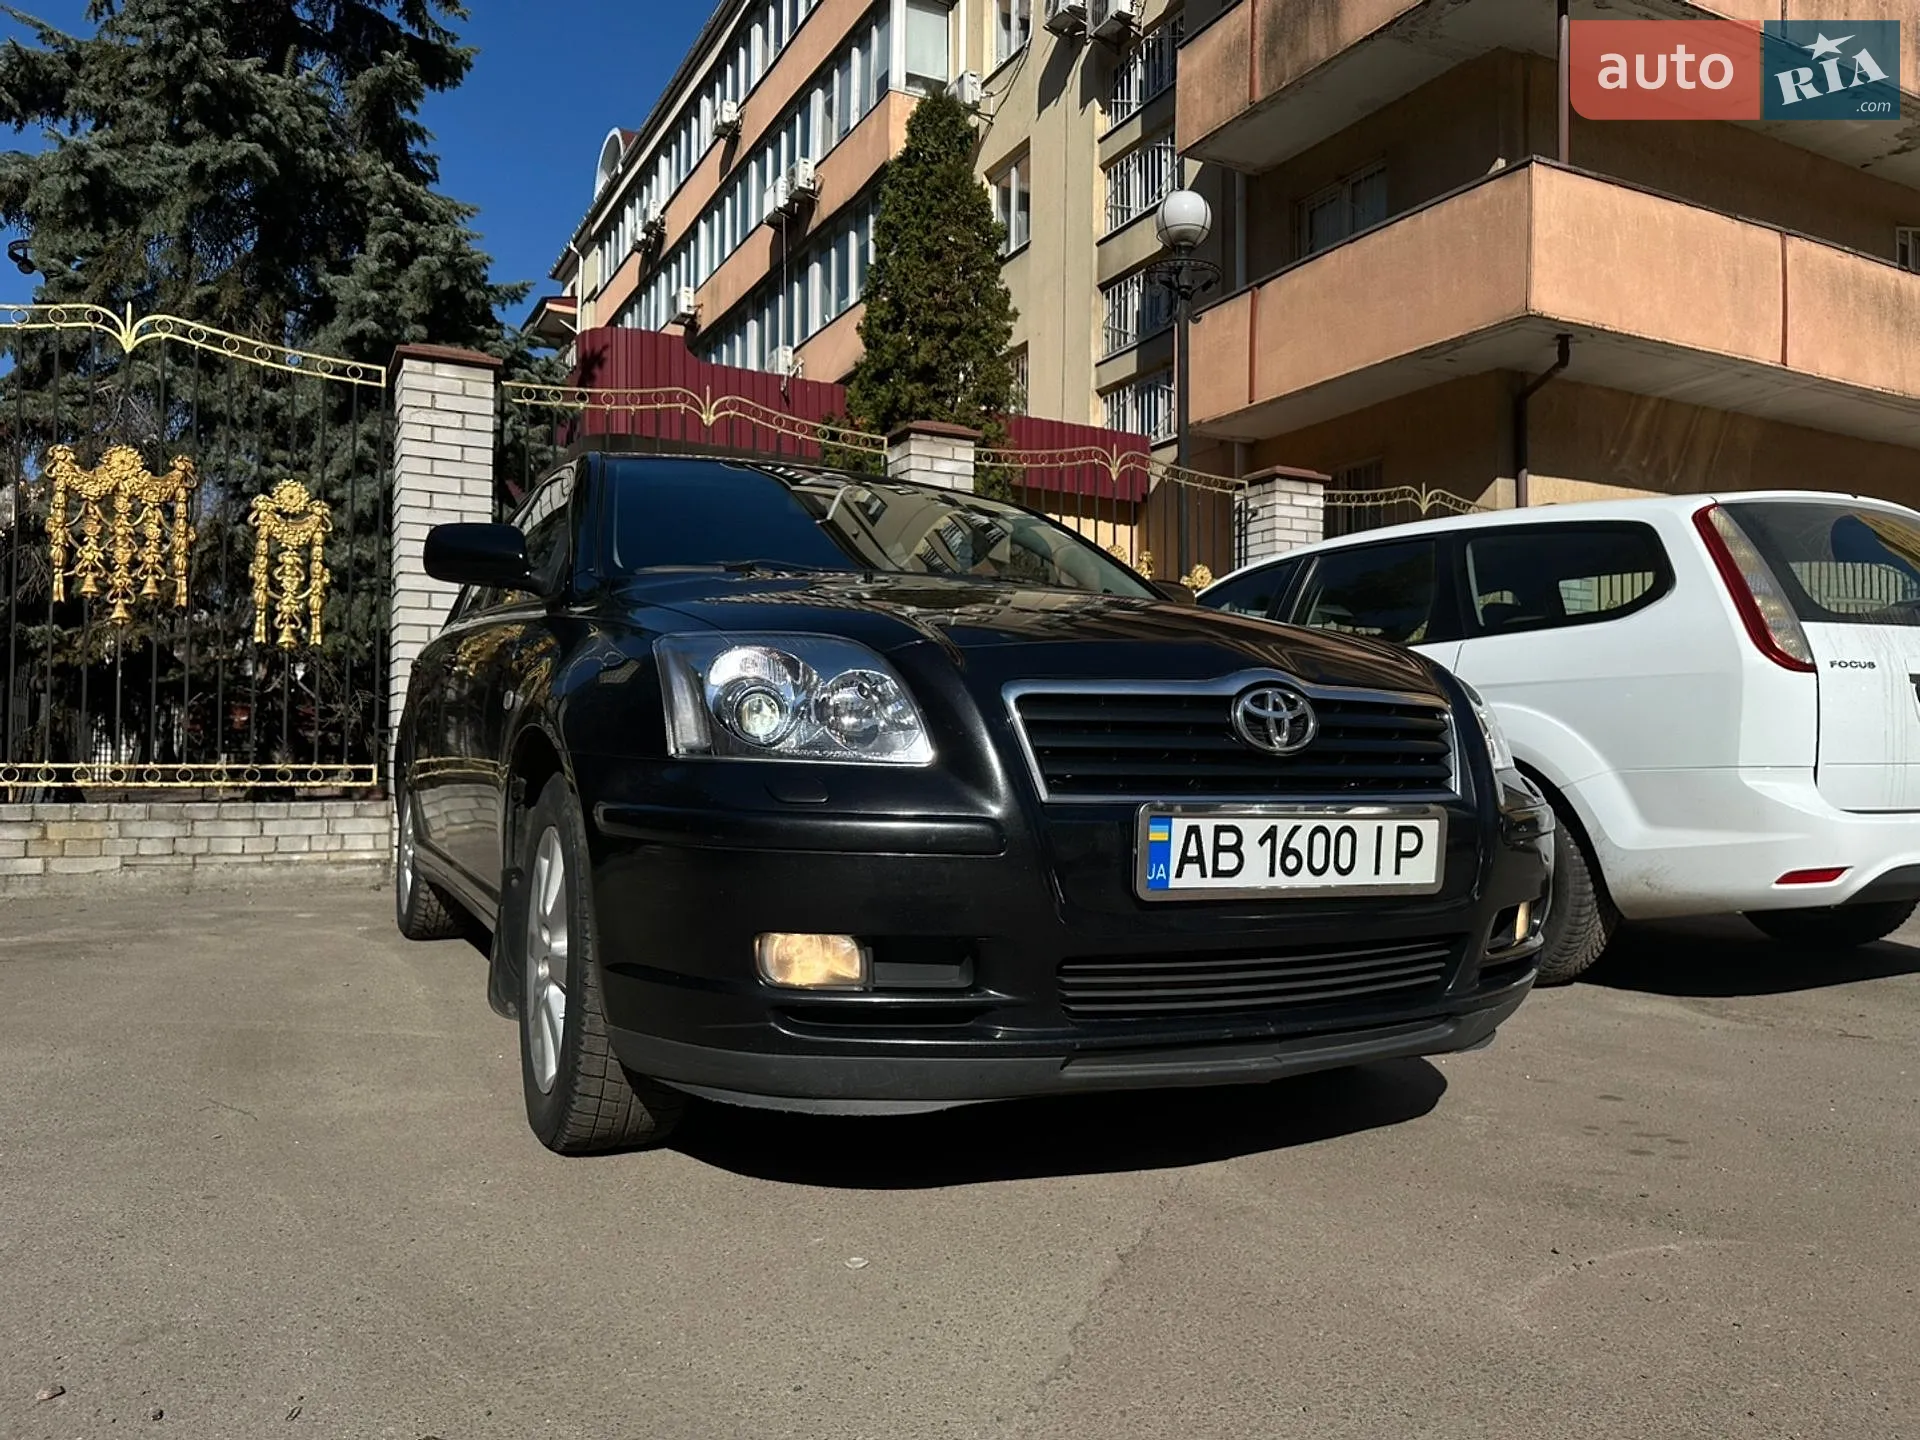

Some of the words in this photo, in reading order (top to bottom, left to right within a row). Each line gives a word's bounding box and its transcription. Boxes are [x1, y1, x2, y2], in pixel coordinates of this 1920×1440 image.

[1829, 660, 1876, 669] FOCUS
[1174, 824, 1245, 879] AB
[1257, 824, 1357, 878] 1600
[1374, 825, 1424, 876] IP
[1146, 863, 1167, 880] UA
